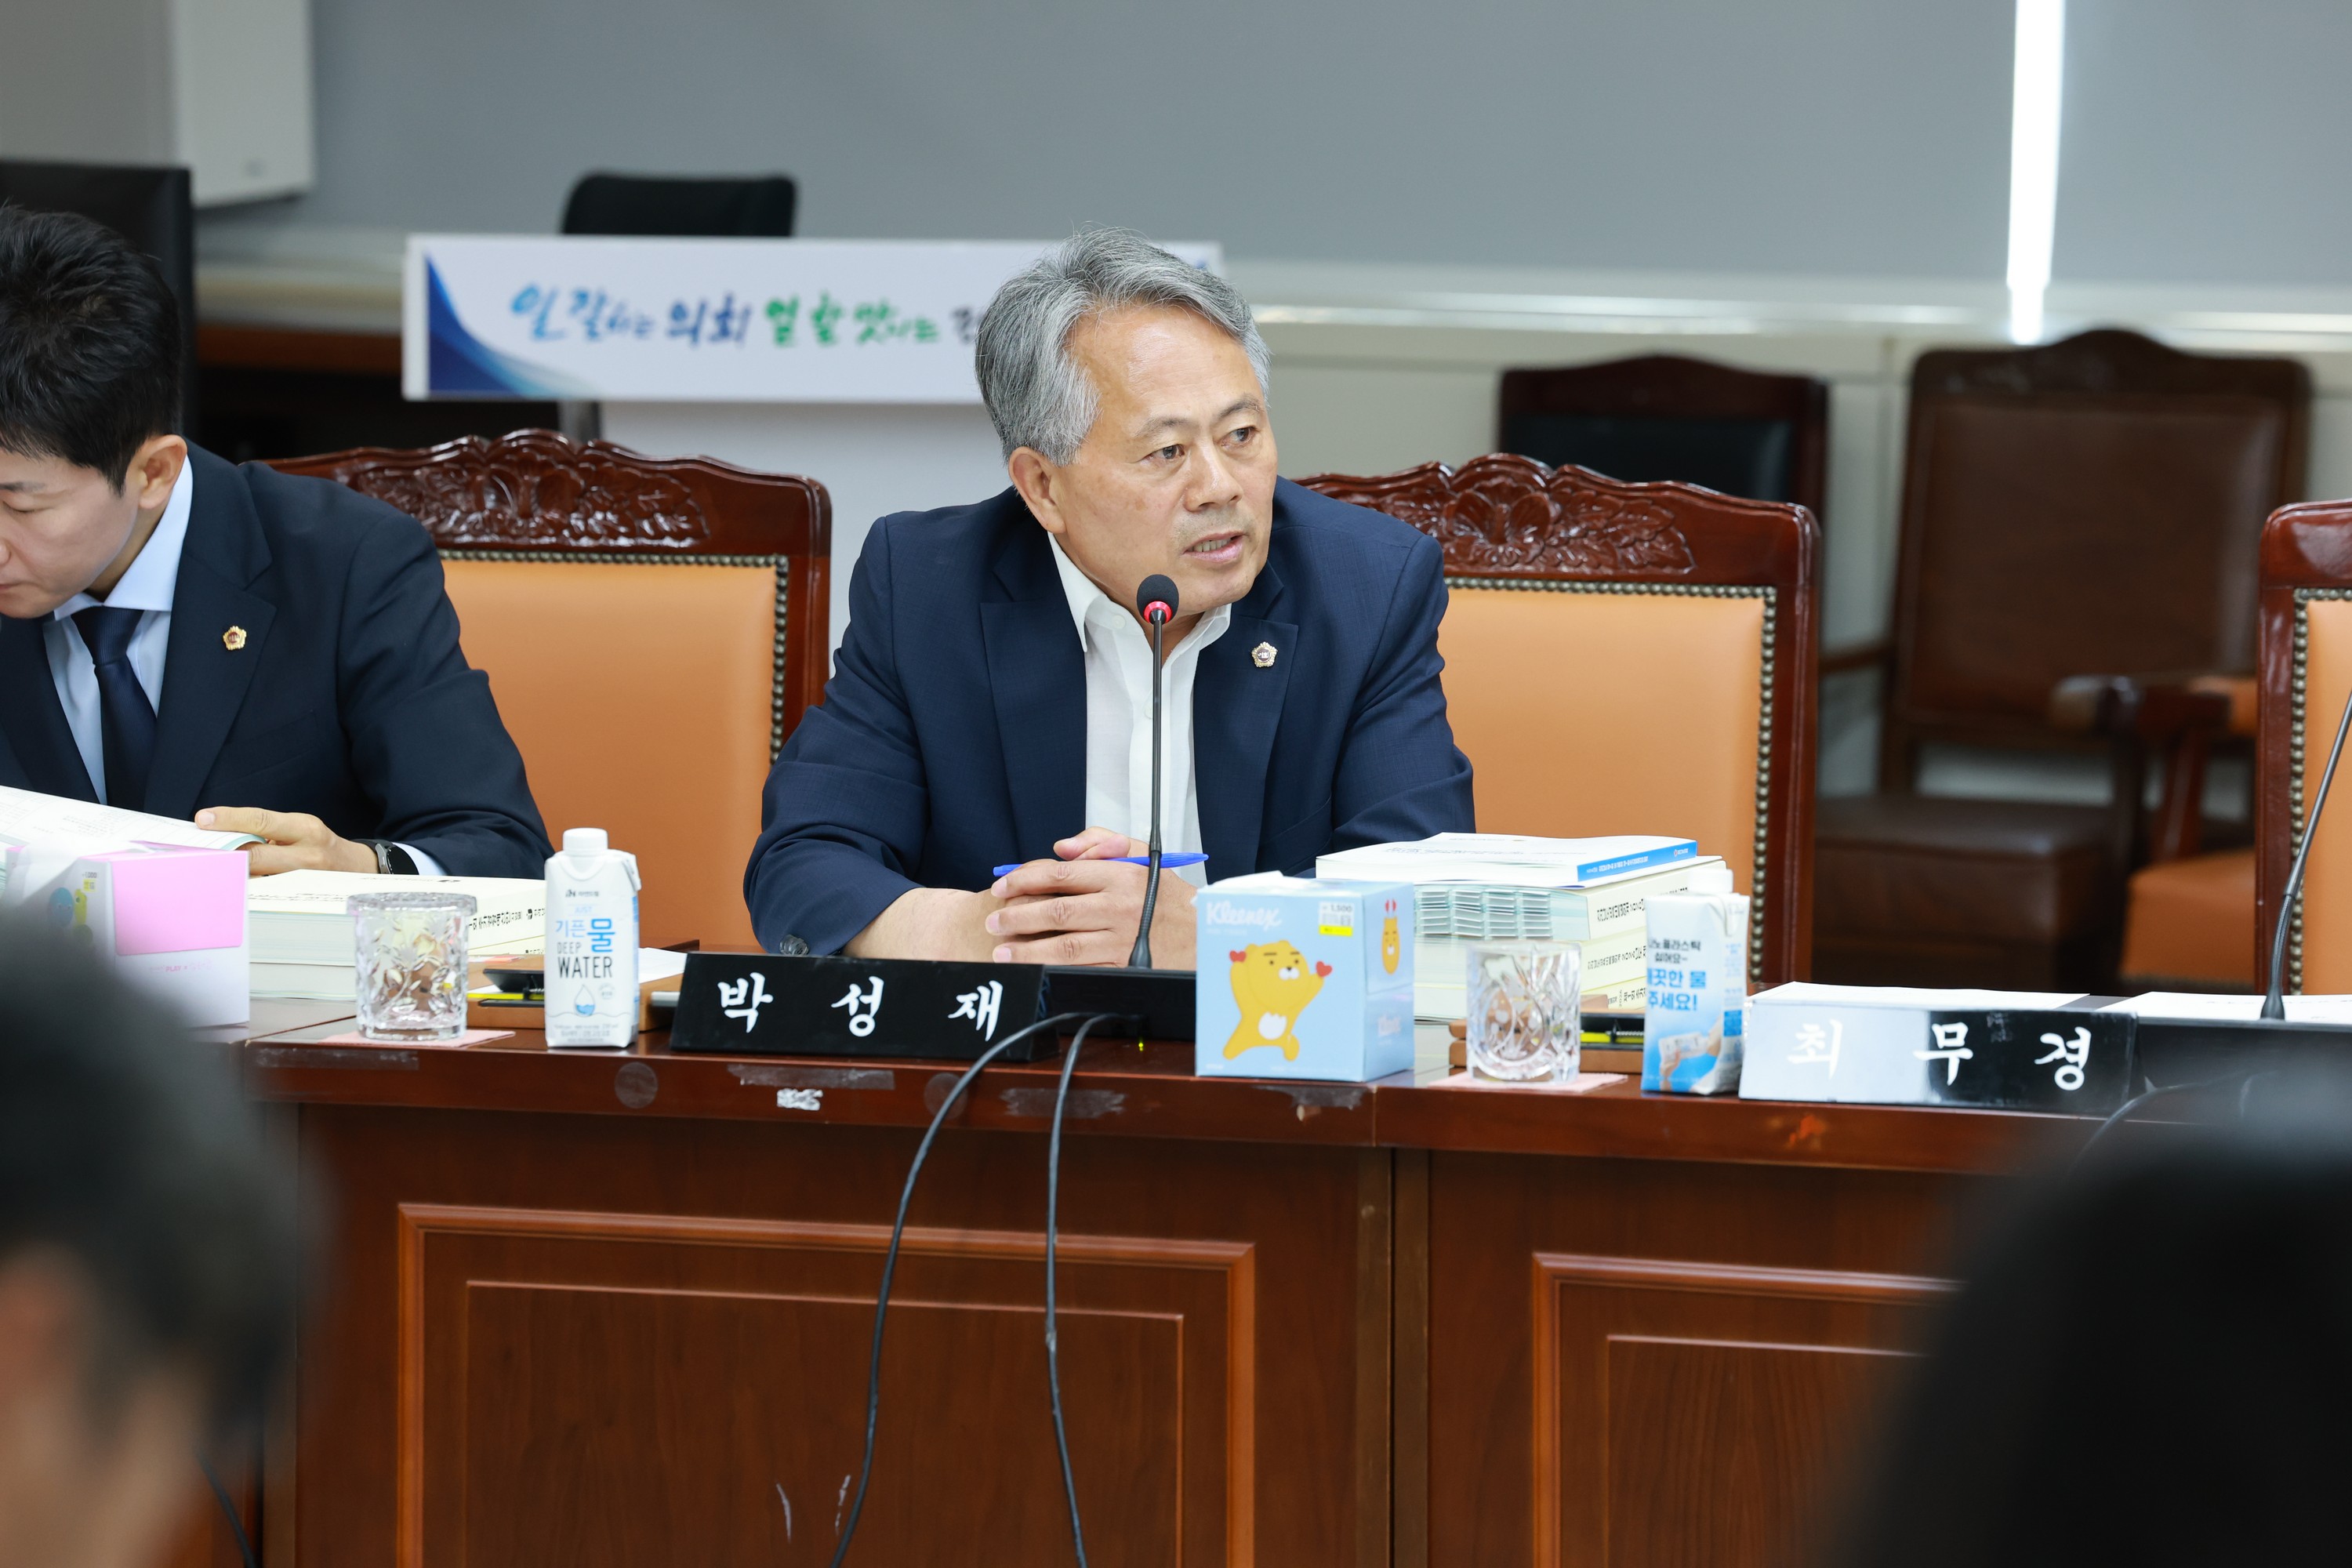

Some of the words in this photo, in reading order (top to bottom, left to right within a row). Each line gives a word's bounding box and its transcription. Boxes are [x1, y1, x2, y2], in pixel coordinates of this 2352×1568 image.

[666, 290, 751, 350] 의회
[1207, 900, 1281, 931] Kleenex
[557, 942, 582, 954] DEEP
[557, 956, 612, 978] WATER
[1690, 971, 1706, 989] 물
[1648, 991, 1697, 1011] 주세요!
